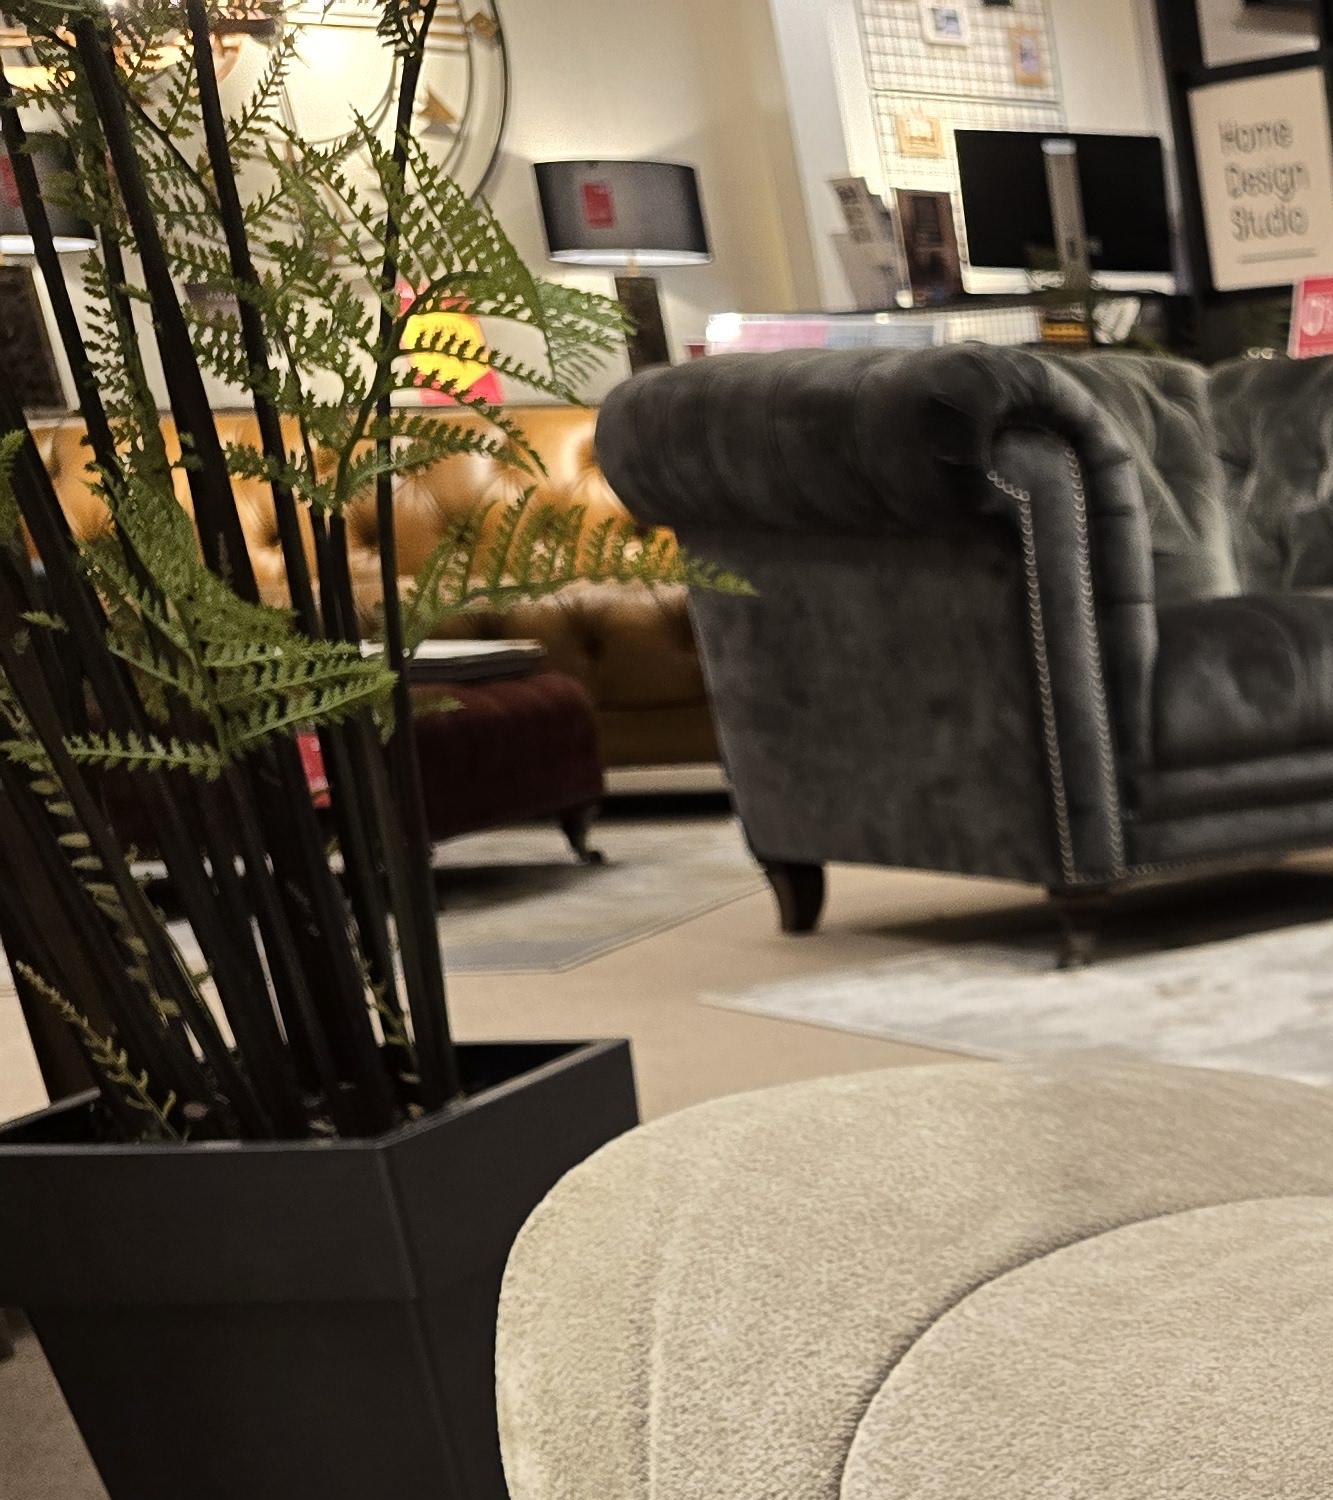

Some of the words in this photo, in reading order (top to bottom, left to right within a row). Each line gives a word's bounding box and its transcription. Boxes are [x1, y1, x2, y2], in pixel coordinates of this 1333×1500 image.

[1218, 121, 1294, 156] Home
[1224, 162, 1311, 202] Design
[1230, 205, 1310, 241] Studio
